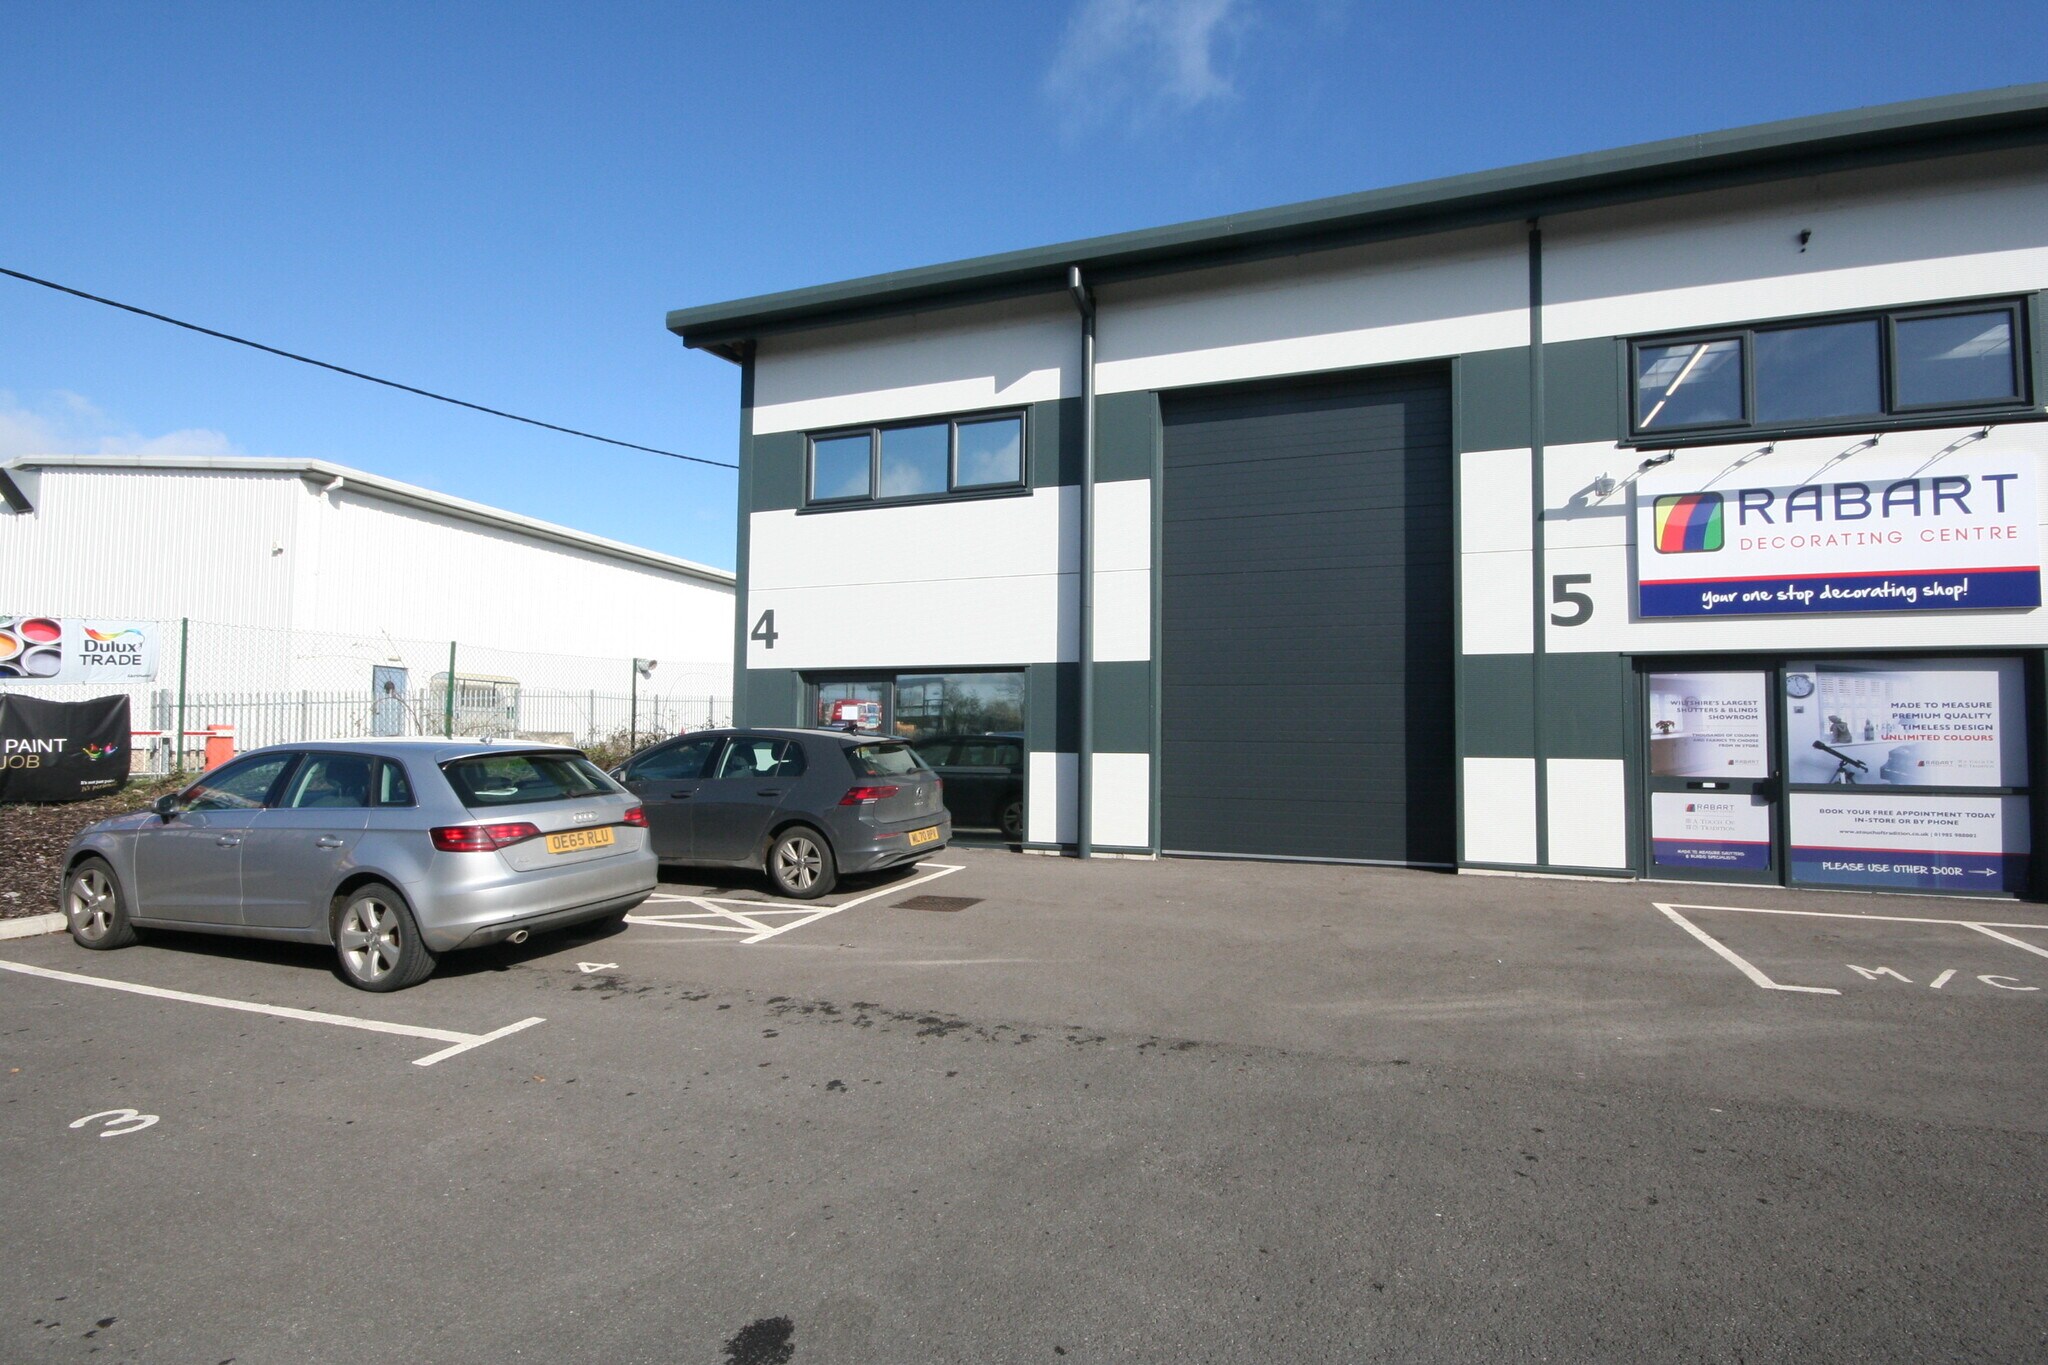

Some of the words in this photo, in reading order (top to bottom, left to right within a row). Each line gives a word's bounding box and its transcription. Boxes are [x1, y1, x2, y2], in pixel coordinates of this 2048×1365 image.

[1739, 473, 2019, 526] RABART
[1740, 530, 1903, 550] DECORATING
[1920, 525, 2018, 543] CENTRE
[1551, 573, 1594, 627] 5
[1702, 590, 1738, 609] your
[1742, 590, 1773, 602] one
[1777, 584, 1814, 605] stop
[1820, 581, 1917, 603] decorating
[1923, 577, 1969, 600] shop!
[751, 609, 778, 649] 4
[84, 639, 137, 652] Dulux
[79, 654, 142, 666] TRADE
[5, 738, 67, 754] PAINT
[0, 754, 40, 770] JOB
[552, 832, 585, 850] OE65
[586, 829, 609, 845] RLU
[1822, 861, 1866, 872] PLEASE
[1867, 863, 1891, 873] USE
[1893, 864, 1929, 875] OTHER
[1931, 866, 1964, 876] DOOR
[575, 961, 620, 974] 4
[69, 1108, 160, 1138] 3
